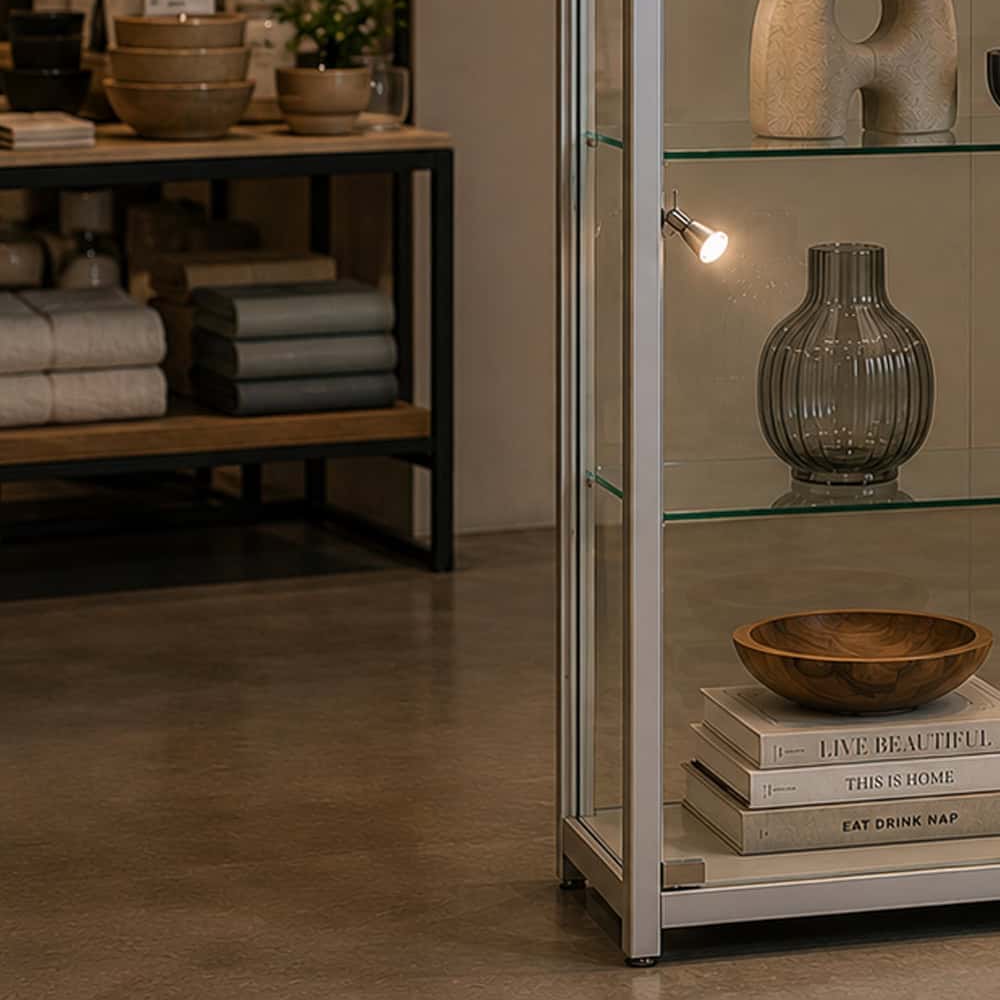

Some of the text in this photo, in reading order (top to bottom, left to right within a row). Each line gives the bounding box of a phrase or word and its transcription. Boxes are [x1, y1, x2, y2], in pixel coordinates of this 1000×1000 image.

[819, 737, 869, 759] LIVE
[874, 729, 992, 754] BEAUTIFUL
[845, 770, 955, 792] THIS IS HOME
[842, 812, 959, 833] EAT DRINK NAP
